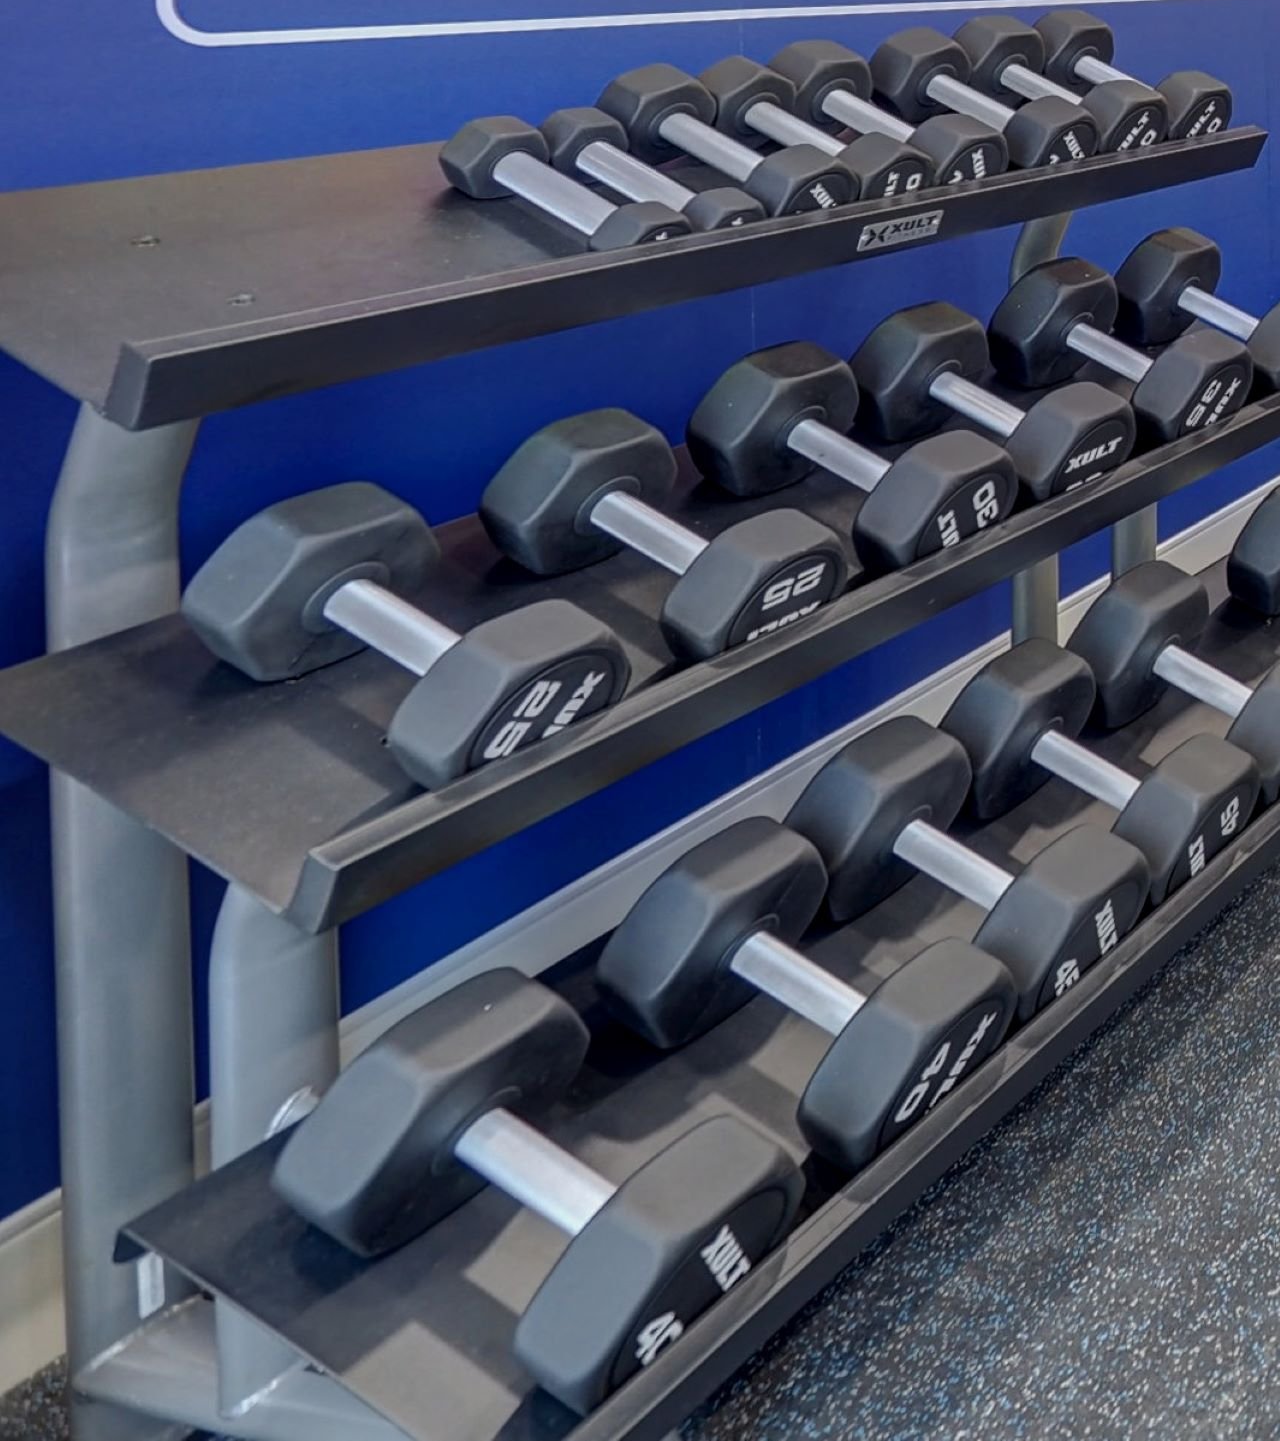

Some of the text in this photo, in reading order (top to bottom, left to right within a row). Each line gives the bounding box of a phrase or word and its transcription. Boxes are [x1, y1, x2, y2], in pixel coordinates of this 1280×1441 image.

[890, 215, 937, 234] XULT
[1185, 378, 1222, 427] 35
[1065, 436, 1121, 474] XULT
[937, 509, 960, 548] ULT
[972, 479, 999, 529] 30
[762, 562, 826, 611] 25
[483, 680, 563, 759] 25
[1220, 796, 1240, 836] 45
[1188, 834, 1206, 878] ULT
[1094, 898, 1119, 955] XULT
[893, 1041, 952, 1123] 40
[700, 1223, 752, 1292] XULT
